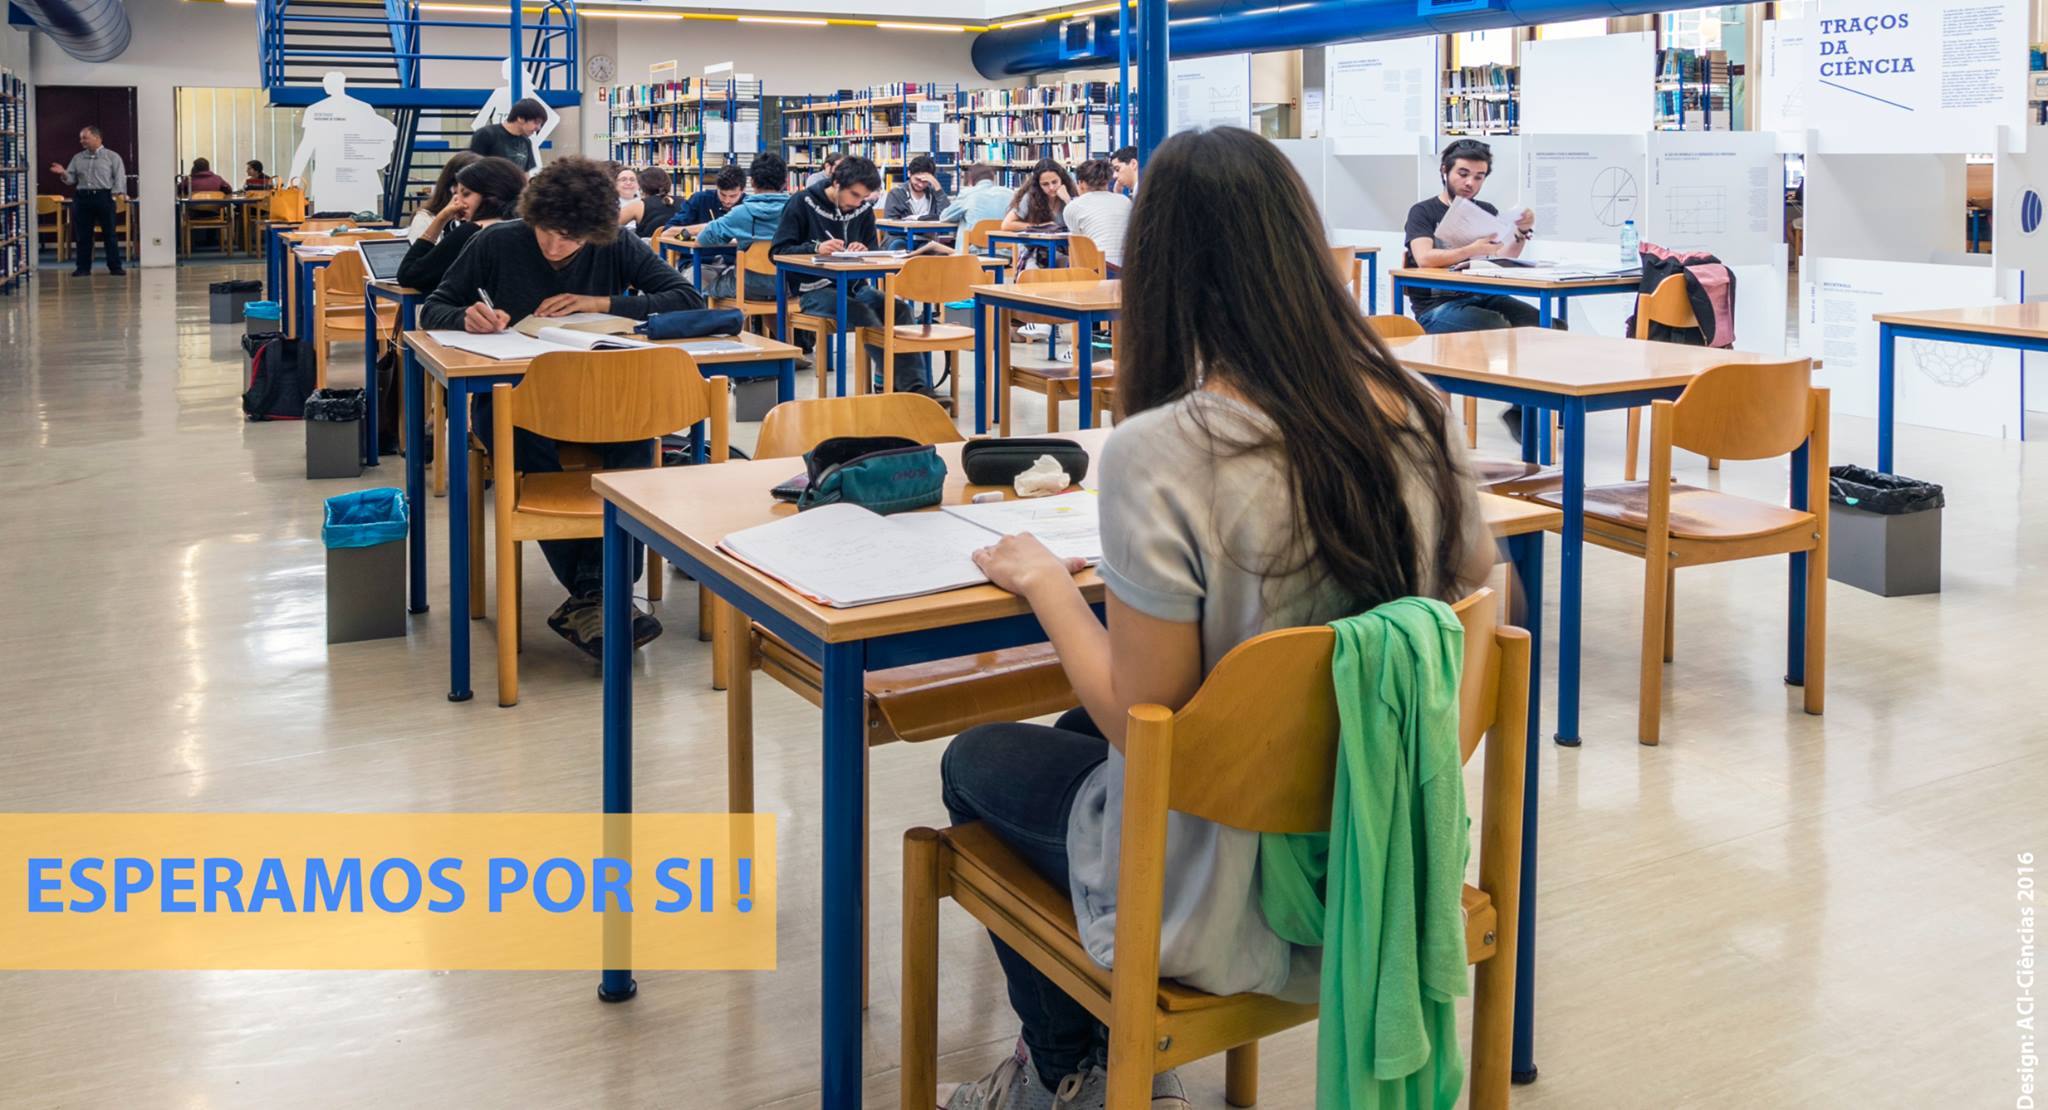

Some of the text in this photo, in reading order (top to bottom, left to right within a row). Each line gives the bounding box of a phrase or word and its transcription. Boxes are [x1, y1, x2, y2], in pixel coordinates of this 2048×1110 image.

[1820, 13, 1910, 36] TRAÇOS
[1819, 40, 1849, 57] DA
[1819, 56, 1916, 77] CIÊNCIA
